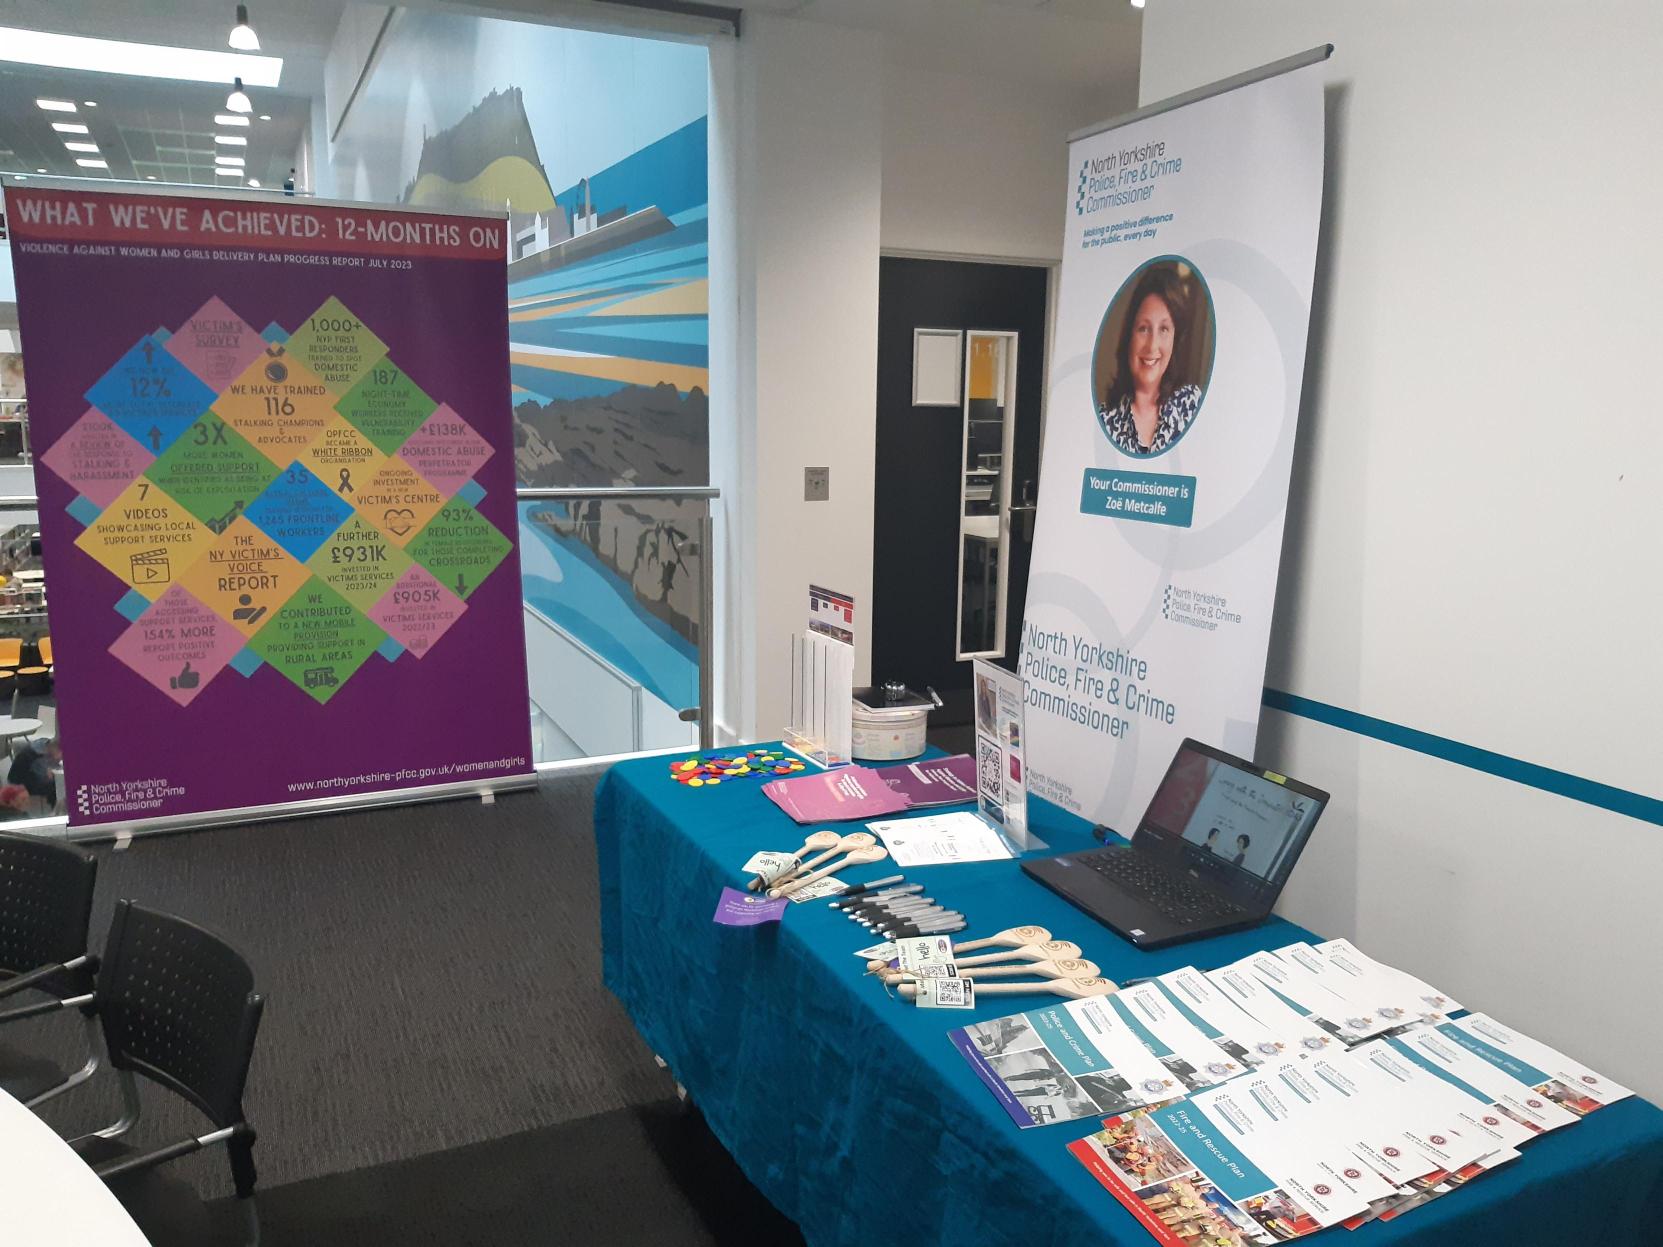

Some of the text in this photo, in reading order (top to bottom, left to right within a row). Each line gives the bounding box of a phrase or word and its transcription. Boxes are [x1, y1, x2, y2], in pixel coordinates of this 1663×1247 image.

[1090, 141, 1165, 175] North Yorkshire
[1089, 157, 1182, 193] Police, Fire & Crime
[1086, 185, 1154, 213] Commissioner
[16, 199, 500, 249] WHAT WE'VE ACHIEVED: 12-MONTHS ON
[1083, 224, 1104, 239] Making
[1110, 218, 1137, 235] positive
[1138, 213, 1174, 227] difference
[1082, 240, 1090, 249] for
[1091, 238, 1099, 247] the
[1124, 231, 1142, 242] every
[1143, 227, 1157, 240] day
[20, 242, 412, 270] VIOLENCE AGAINST WOMEN AND GIRLS DELIVERY PLAN PROGRESS REPORT JULY 2023
[310, 318, 362, 333] 1,000+
[195, 335, 240, 346] SURVEY
[309, 345, 358, 353] RESPONDERS
[313, 363, 358, 372] DOMESTIC
[324, 374, 350, 382] ABUSE
[373, 370, 399, 385] 187
[130, 377, 172, 398] 12%
[230, 385, 326, 396] WE HAVE TRAINED
[264, 397, 295, 416] 116
[367, 400, 407, 408] ECONOMY
[234, 419, 325, 427] STALKING CHAMPIONS
[258, 436, 307, 444] ADVOCATES
[326, 430, 356, 438] OPFCC
[312, 448, 373, 456] WHITE RIBBON
[402, 447, 486, 456] DOMESTIC ABUSE
[171, 462, 259, 472] OFFERED SUPPORT
[286, 470, 308, 484] 35
[374, 478, 419, 486] INVESTMENT
[138, 484, 149, 501] 7
[1090, 476, 1189, 499] Your Commissioner is
[357, 493, 440, 505] VICTIM'S CENTRE
[1106, 496, 1167, 516] Zoë Metcalfe
[124, 508, 168, 519] VIDEOS
[442, 508, 474, 522] 93%
[97, 521, 196, 533] SHOWCASING LOCAL
[354, 520, 361, 529] A
[428, 526, 488, 536] REDUCTION
[277, 528, 325, 536] WORKERS
[337, 531, 379, 542] FURTHER
[104, 534, 192, 545] SUPPORT SERVICES
[234, 536, 254, 545] THE
[209, 548, 280, 560] NY VICTIM'S
[331, 545, 387, 563] £931K
[228, 562, 264, 572] VOICE
[429, 556, 490, 567] CROSSROADS
[218, 575, 278, 591] REPORT
[360, 572, 394, 581] SERVICES
[308, 594, 323, 603] WE
[393, 590, 440, 604] £905K
[1173, 586, 1226, 608] North Yorkshire
[280, 607, 352, 619] CONTRIBUTED
[1193, 603, 1207, 616] Fire
[1207, 605, 1213, 617] &
[1215, 606, 1242, 624] Crime
[1170, 610, 1218, 631] Commissioner
[144, 626, 216, 640] 154% MORE
[294, 631, 339, 639] PROVISION
[178, 640, 216, 650] POSITIVE
[267, 639, 366, 652] PROVIDING SUPPORT IN
[1027, 623, 1147, 681] North Yorkshire
[158, 652, 206, 662] OUTCOMES
[285, 651, 353, 664] RURAL AREAS
[1025, 652, 1175, 725] Police, Fire & Crime
[1023, 681, 1129, 739] Commissioner
[287, 756, 526, 792] www.northyorkshire-pfcc.gov.uk/womenandgirls
[91, 778, 167, 794] North Yorkshire
[1030, 768, 1072, 795] North Yorkshire
[92, 785, 185, 804] Police, Fire & Crime
[93, 799, 163, 814] Commissioner
[760, 858, 781, 872] hello
[916, 942, 931, 961] hello
[1048, 1010, 1095, 1067] Police and Crime Plan
[1176, 1110, 1245, 1178] Fire and Rescue Plan
